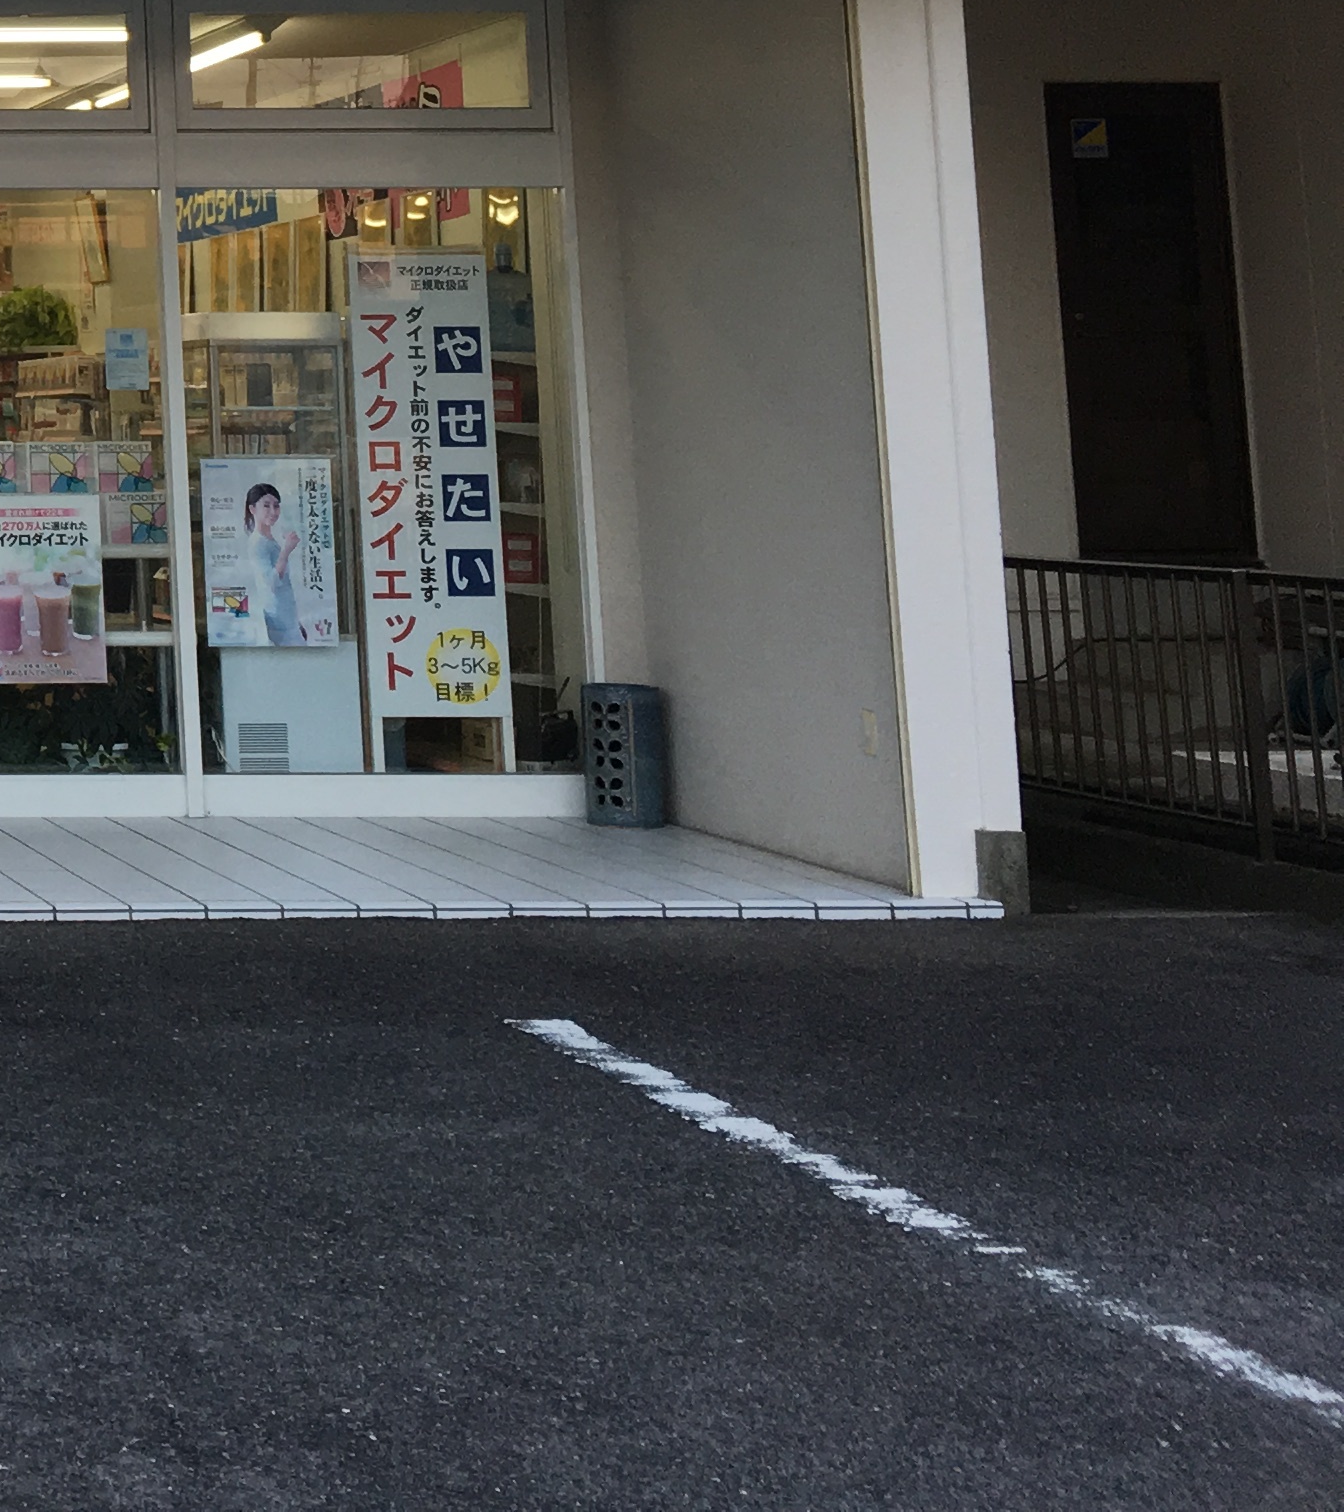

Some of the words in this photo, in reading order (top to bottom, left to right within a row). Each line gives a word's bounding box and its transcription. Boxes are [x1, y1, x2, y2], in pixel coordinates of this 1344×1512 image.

[397, 265, 480, 276] マイクロダイエット
[410, 279, 469, 291] 正規取扱店
[29, 444, 82, 452] MICRODIET
[360, 314, 416, 690] マイクロダイエット
[405, 306, 441, 610] ダイエット前の不安にお答えします。
[436, 329, 492, 590] やせたい
